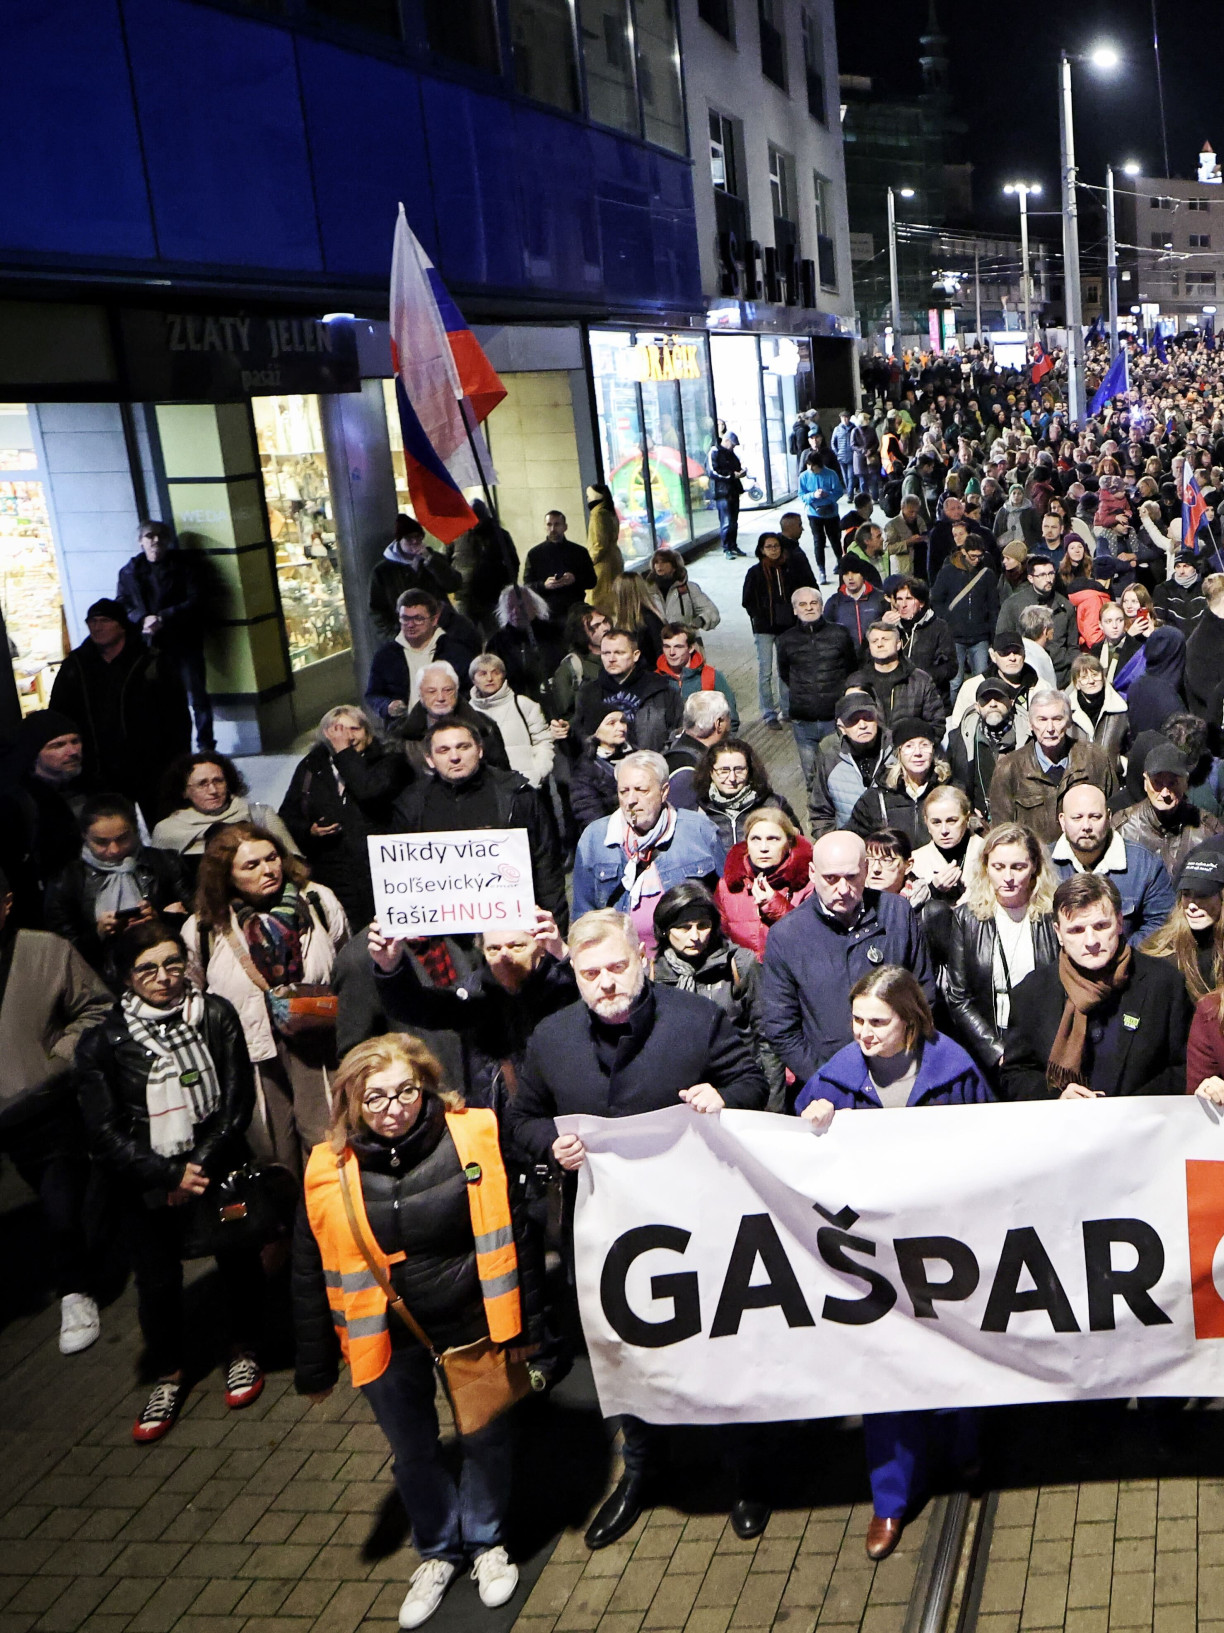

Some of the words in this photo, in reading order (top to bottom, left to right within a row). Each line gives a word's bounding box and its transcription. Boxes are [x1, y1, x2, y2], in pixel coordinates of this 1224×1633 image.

[166, 310, 250, 352] ZLATÝ
[381, 842, 446, 863] Nikdy
[455, 841, 500, 858] viac
[384, 873, 484, 894] boľševický
[599, 1202, 1173, 1348] GAŠPAR
